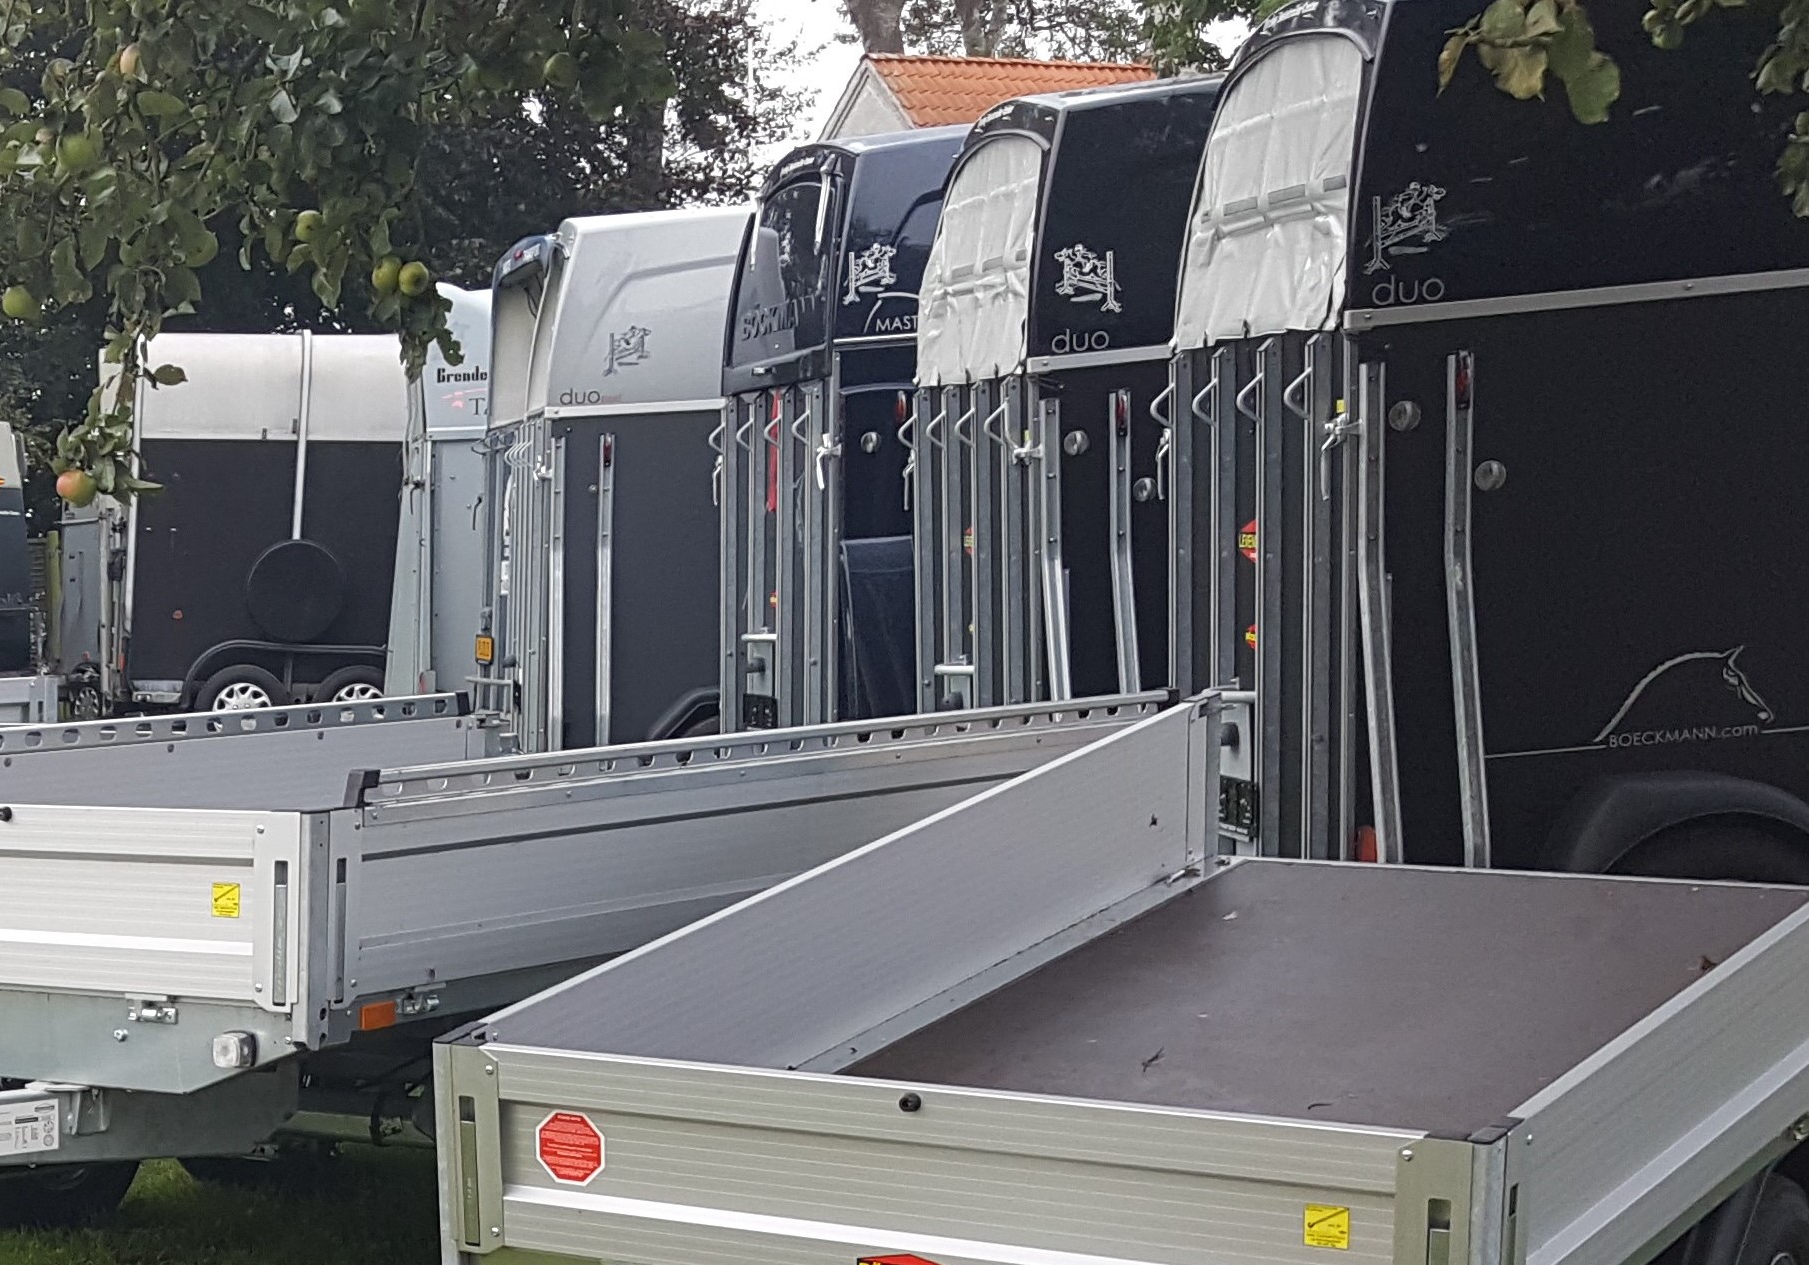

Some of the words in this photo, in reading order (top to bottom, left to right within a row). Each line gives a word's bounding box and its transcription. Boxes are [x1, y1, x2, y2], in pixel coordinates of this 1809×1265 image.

[1372, 274, 1445, 306] duo
[1051, 328, 1110, 354] duo
[559, 387, 601, 406] duo
[1609, 724, 1758, 748] BOECKMANN.com
